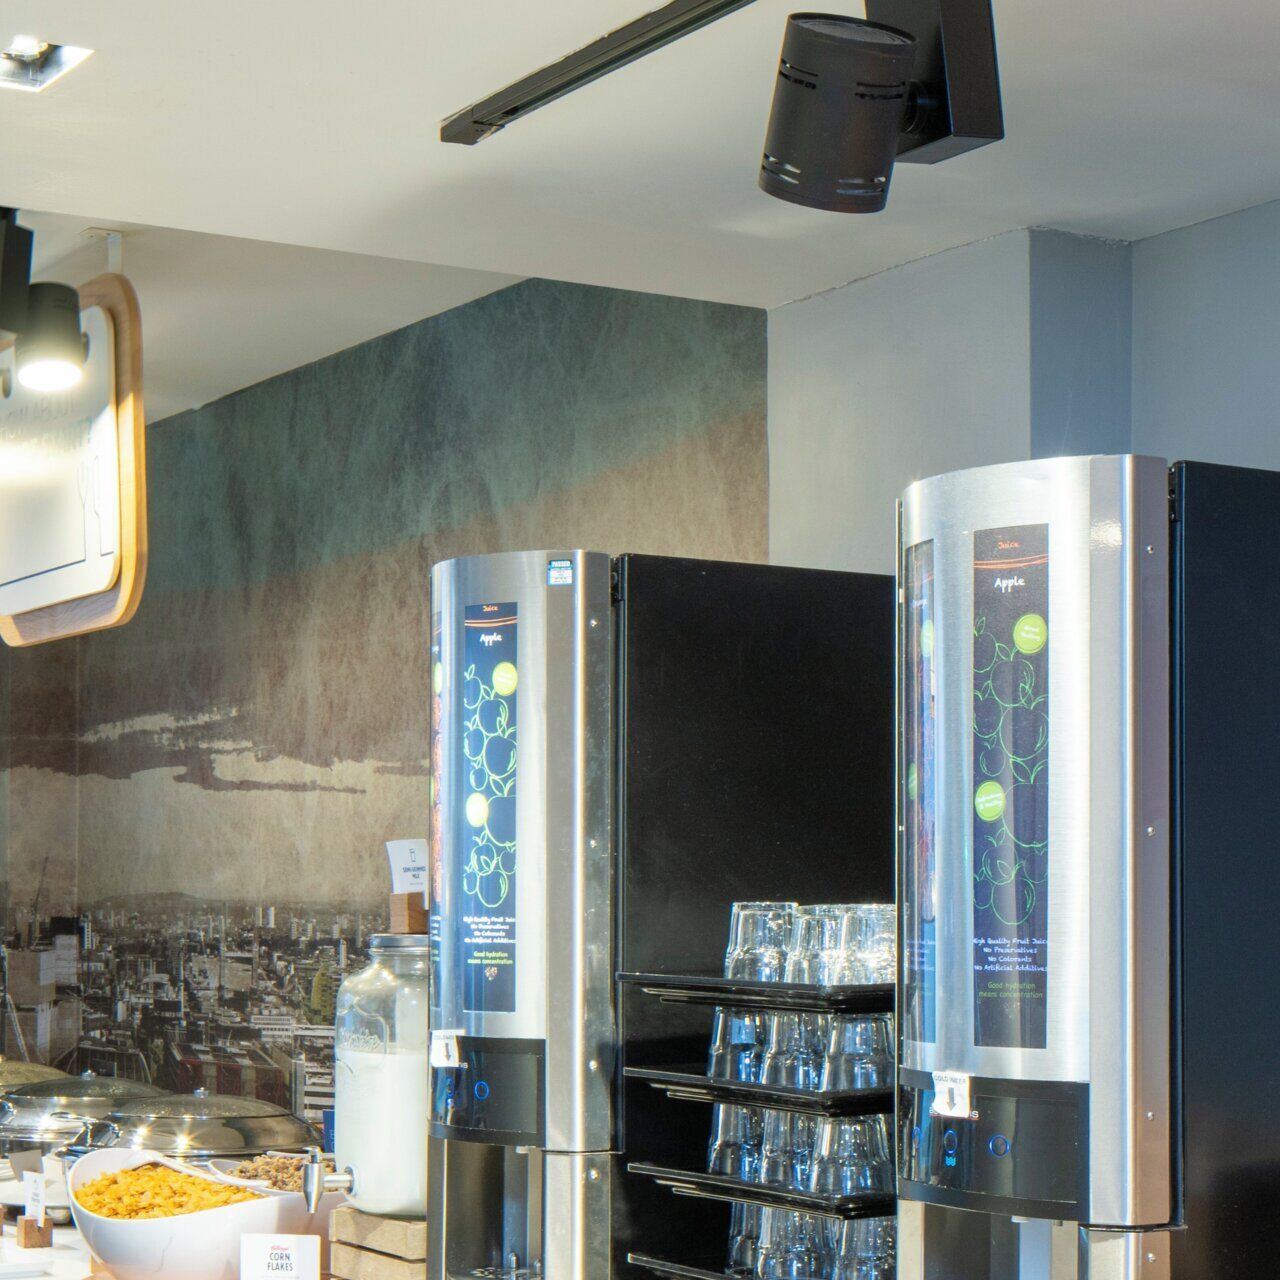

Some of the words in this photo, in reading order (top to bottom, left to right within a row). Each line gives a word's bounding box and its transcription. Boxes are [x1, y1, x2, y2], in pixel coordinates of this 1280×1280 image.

[994, 576, 1025, 593] Apple
[480, 632, 502, 646] Apple
[269, 1252, 291, 1262] CORN
[267, 1262, 294, 1272] FLAKES
